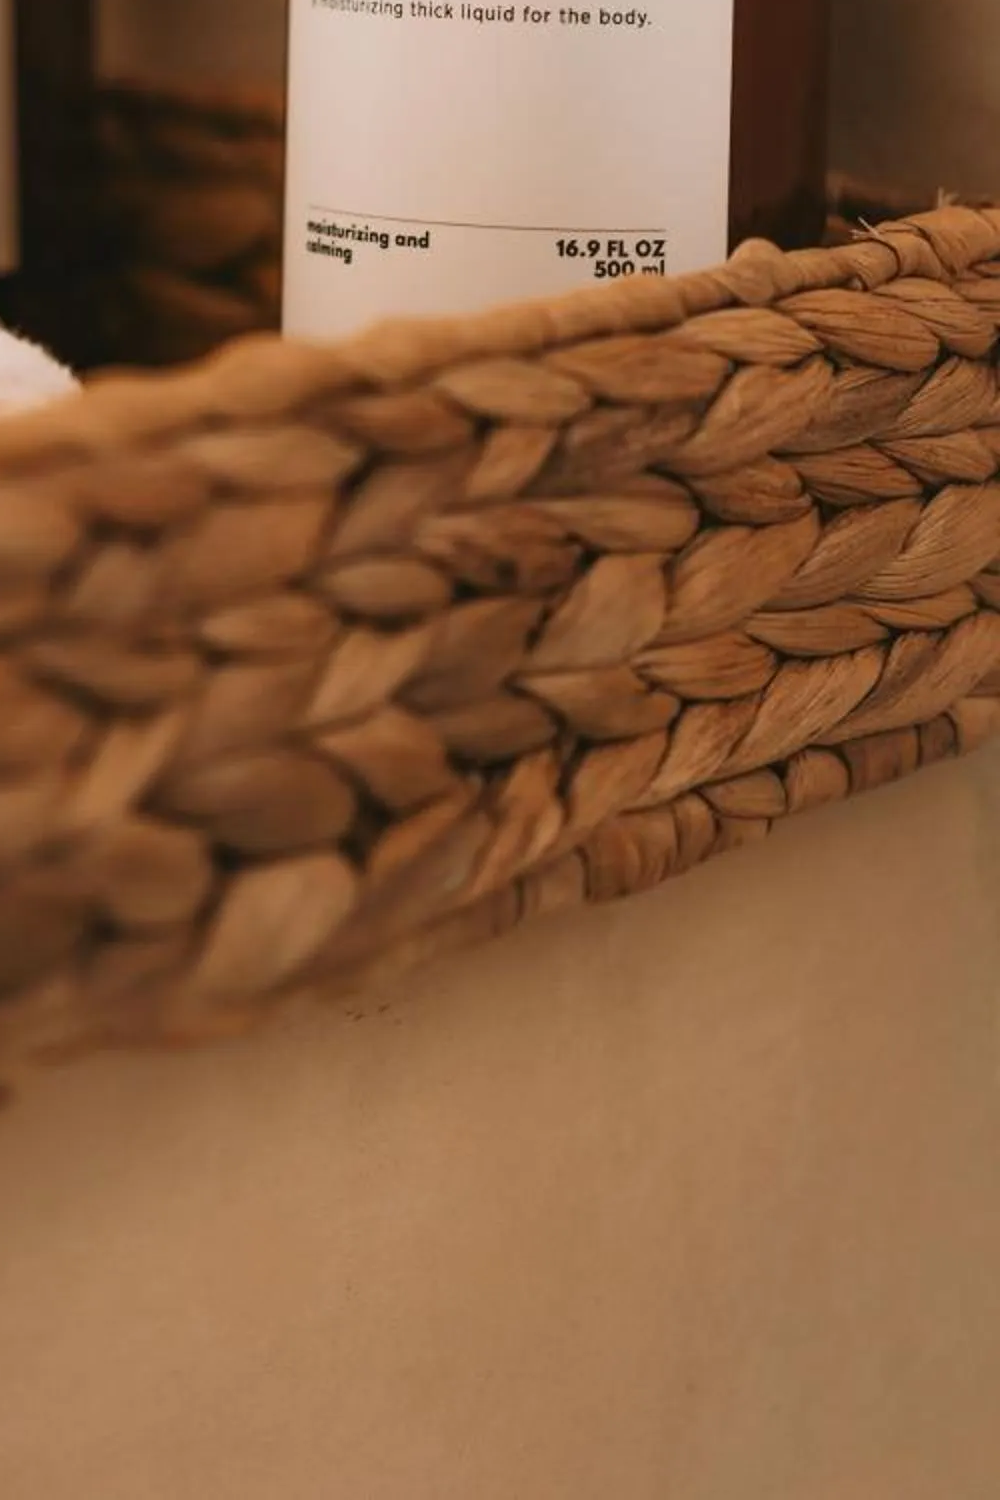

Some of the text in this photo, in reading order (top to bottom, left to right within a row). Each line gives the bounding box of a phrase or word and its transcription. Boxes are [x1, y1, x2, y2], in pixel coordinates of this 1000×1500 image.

[410, 1, 454, 20] thick
[461, 3, 515, 24] liquid
[522, 6, 551, 24] for
[559, 7, 591, 25] the
[599, 9, 653, 29] body.
[306, 218, 430, 249] moisturizing and
[555, 239, 666, 258] 16.9 FL OZ
[593, 260, 666, 278] 500 ml
